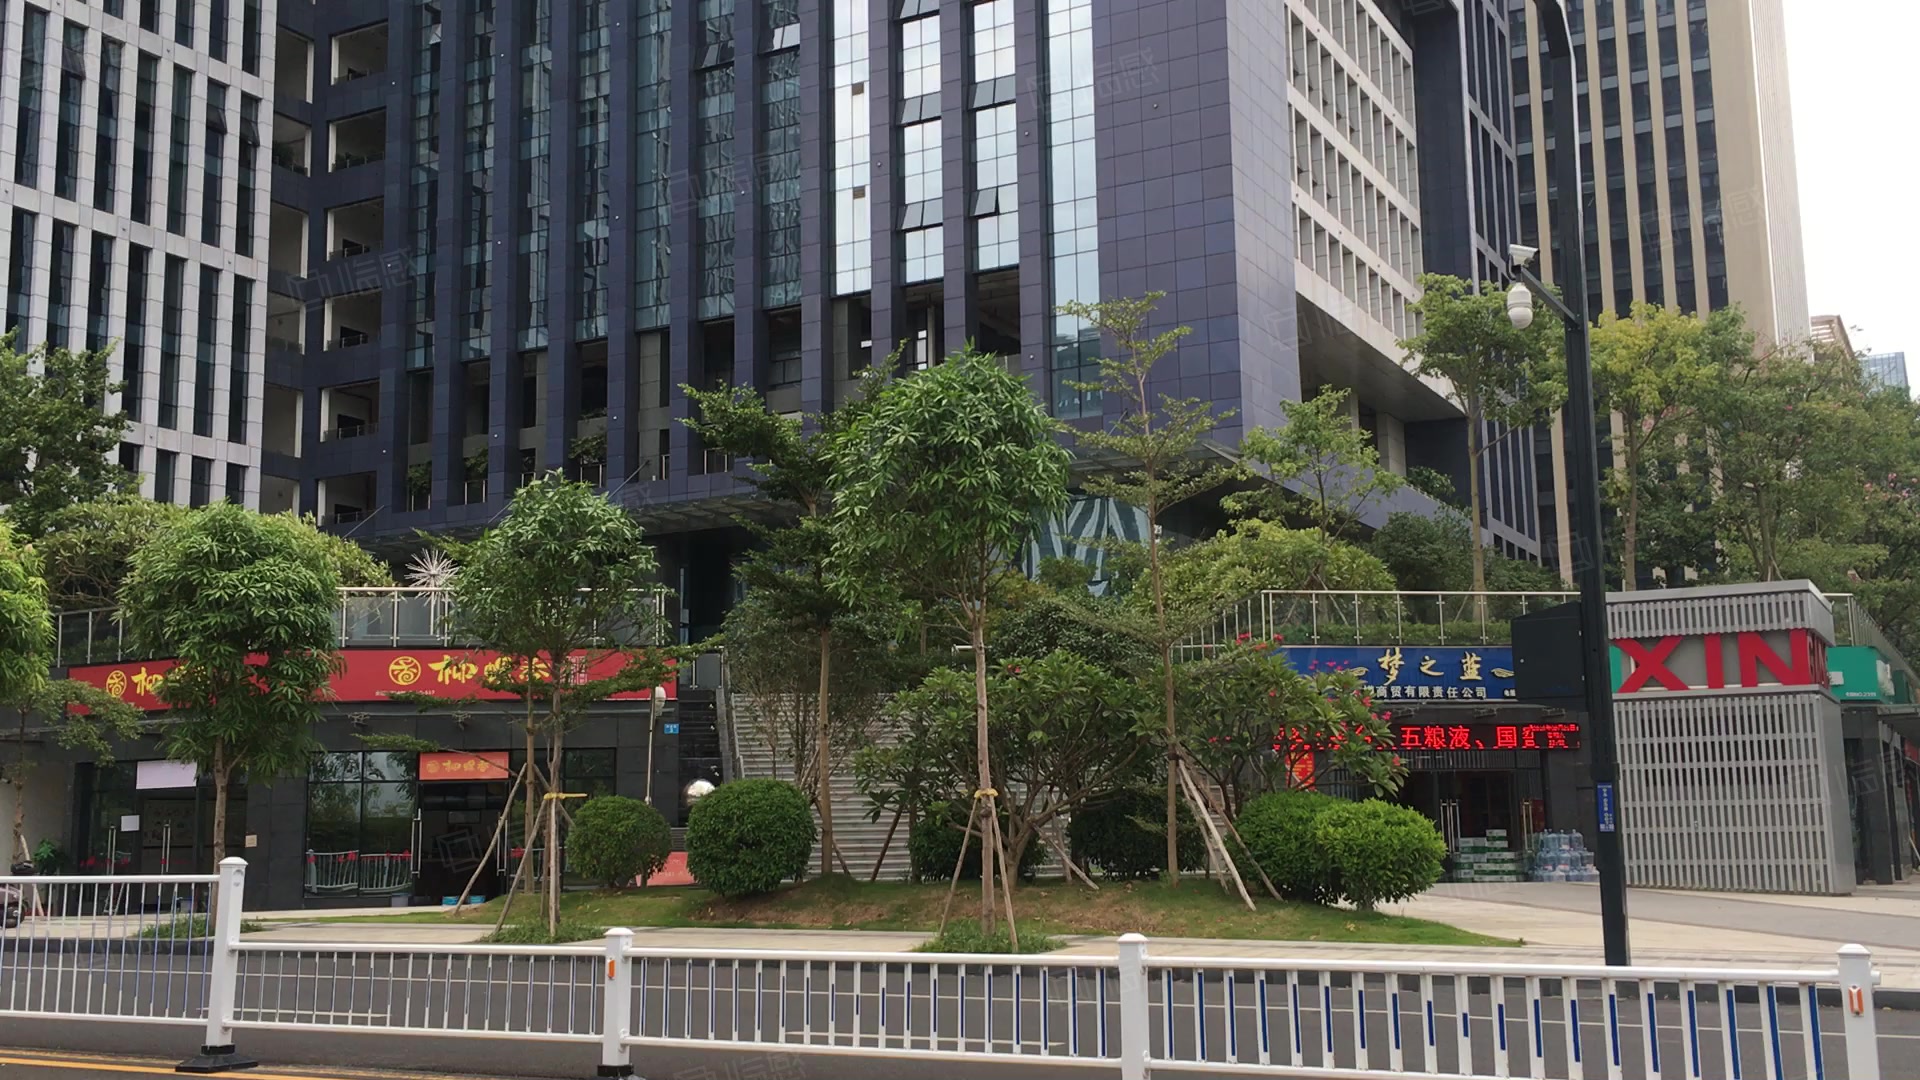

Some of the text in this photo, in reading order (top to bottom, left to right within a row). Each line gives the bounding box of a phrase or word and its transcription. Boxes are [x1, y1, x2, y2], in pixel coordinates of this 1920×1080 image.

[1378, 647, 1482, 685] 梦之蓝
[1613, 627, 1813, 693] XIN
